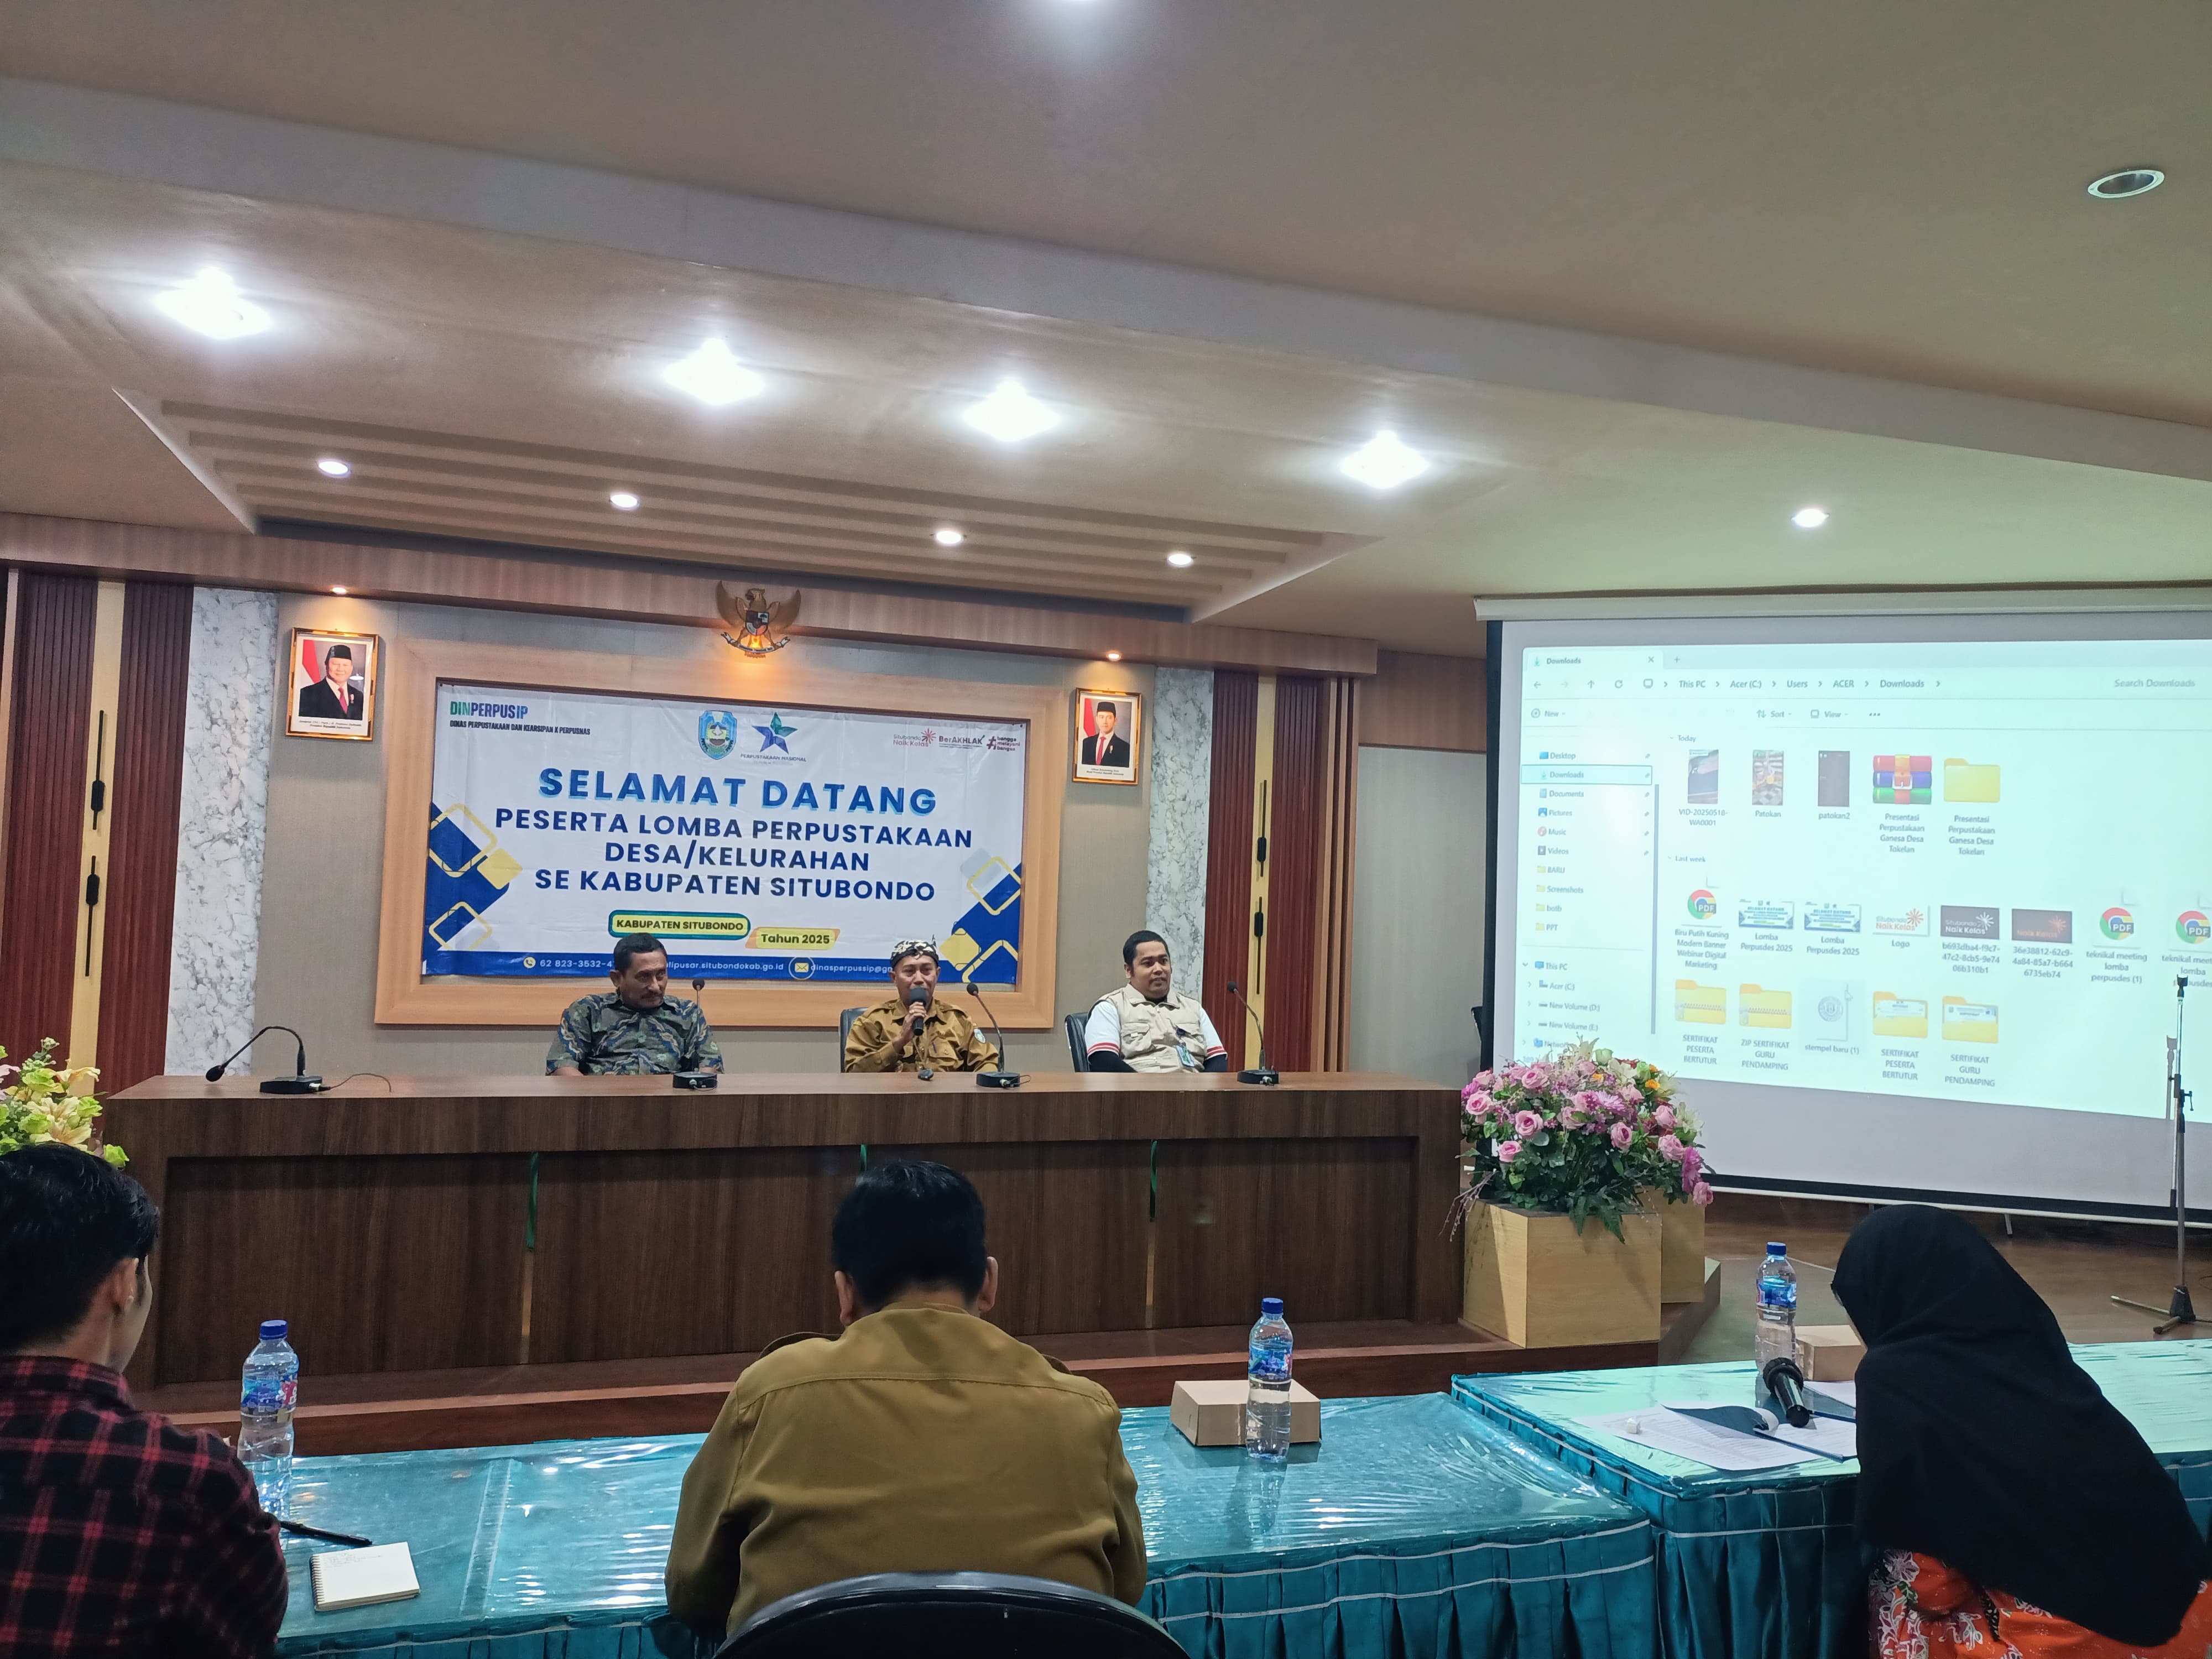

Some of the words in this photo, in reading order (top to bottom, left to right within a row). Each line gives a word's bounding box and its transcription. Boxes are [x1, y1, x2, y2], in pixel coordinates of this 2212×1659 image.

[1750, 680, 1762, 689] (C:)
[1880, 679, 1924, 688] Downloads
[2114, 678, 2143, 688] Search
[2146, 678, 2195, 688] Downloads
[450, 701, 528, 719] DINPERPUSIP
[468, 721, 509, 730] PERPUSTAKAAN
[559, 727, 591, 735] PERPUSNAS
[939, 735, 984, 745] BerAKHLAK
[1678, 734, 1696, 743] Today
[1550, 752, 1576, 760] Desktop
[538, 768, 746, 806] SELAMAT
[761, 780, 937, 816] DATANG
[1818, 812, 1850, 820] patokan2
[1885, 813, 1919, 821] Presentasi
[1954, 815, 1990, 823] Presentasi
[495, 808, 625, 833] PESERTA
[639, 814, 742, 838] LOMBA
[752, 820, 973, 849] PERPUSTAKAAN
[1879, 823, 1924, 832] Perpustakaan
[1948, 825, 1995, 834] Perpustakaan
[1880, 834, 1905, 842] Ganesa
[1906, 834, 1924, 843] Desa
[1949, 836, 1975, 844] Ganesa
[1976, 837, 1994, 845] Desa
[1889, 845, 1915, 853] Tokelan
[1958, 847, 1985, 856] Tokelan
[605, 839, 870, 872] DESA/KELURAHAN
[535, 869, 570, 891] SE
[580, 870, 760, 896] KABUPATEN
[770, 877, 936, 901] SITUBONDO
[1547, 885, 1584, 894] Screenshots
[616, 920, 680, 930] KABUPATEN
[682, 921, 744, 931] SITUBONDO
[1706, 931, 1729, 940] Kuning
[1964, 927, 1986, 935] Kelas
[2188, 927, 2209, 936] PDF
[761, 933, 799, 944] Tahun
[802, 935, 830, 945] 2025
[1740, 943, 1774, 951] Perpusdes
[1775, 943, 1793, 952] 2025
[1891, 940, 1910, 948] Logo
[1705, 951, 1726, 960] Digital
[1806, 946, 1840, 955] Perpusdes
[1842, 947, 1860, 956] 2025
[2116, 953, 2147, 962] meeting
[2162, 954, 2192, 963] teknikal
[1685, 960, 1717, 970] Marketing
[2105, 962, 2129, 971] lomba
[2180, 966, 2206, 975] lomba
[2091, 974, 2130, 983] perpusdes
[2132, 975, 2143, 984] (1)
[1683, 1034, 1718, 1044] SERTIFIKAT
[1741, 1039, 1752, 1047] ZIP
[1753, 1040, 1790, 1049] SERTIFIKAT
[1687, 1045, 1714, 1054] PESERTA
[1805, 1044, 1832, 1053] stempel
[1833, 1045, 1849, 1053] baru
[1850, 1047, 1859, 1055] (1)
[1881, 1048, 1919, 1058] SERTIFIKAT
[1755, 1050, 1775, 1059] GURU
[1950, 1054, 1990, 1064] SERTIFIKAT
[1683, 1055, 1717, 1065] BERTUTUR
[1885, 1060, 1916, 1069] PESERTA
[1741, 1060, 1789, 1071] PENDAMPING
[1959, 1066, 1980, 1075] GURU
[1882, 1071, 1918, 1080] BERTUTUR
[1944, 1076, 1995, 1087] PENDAMPING
